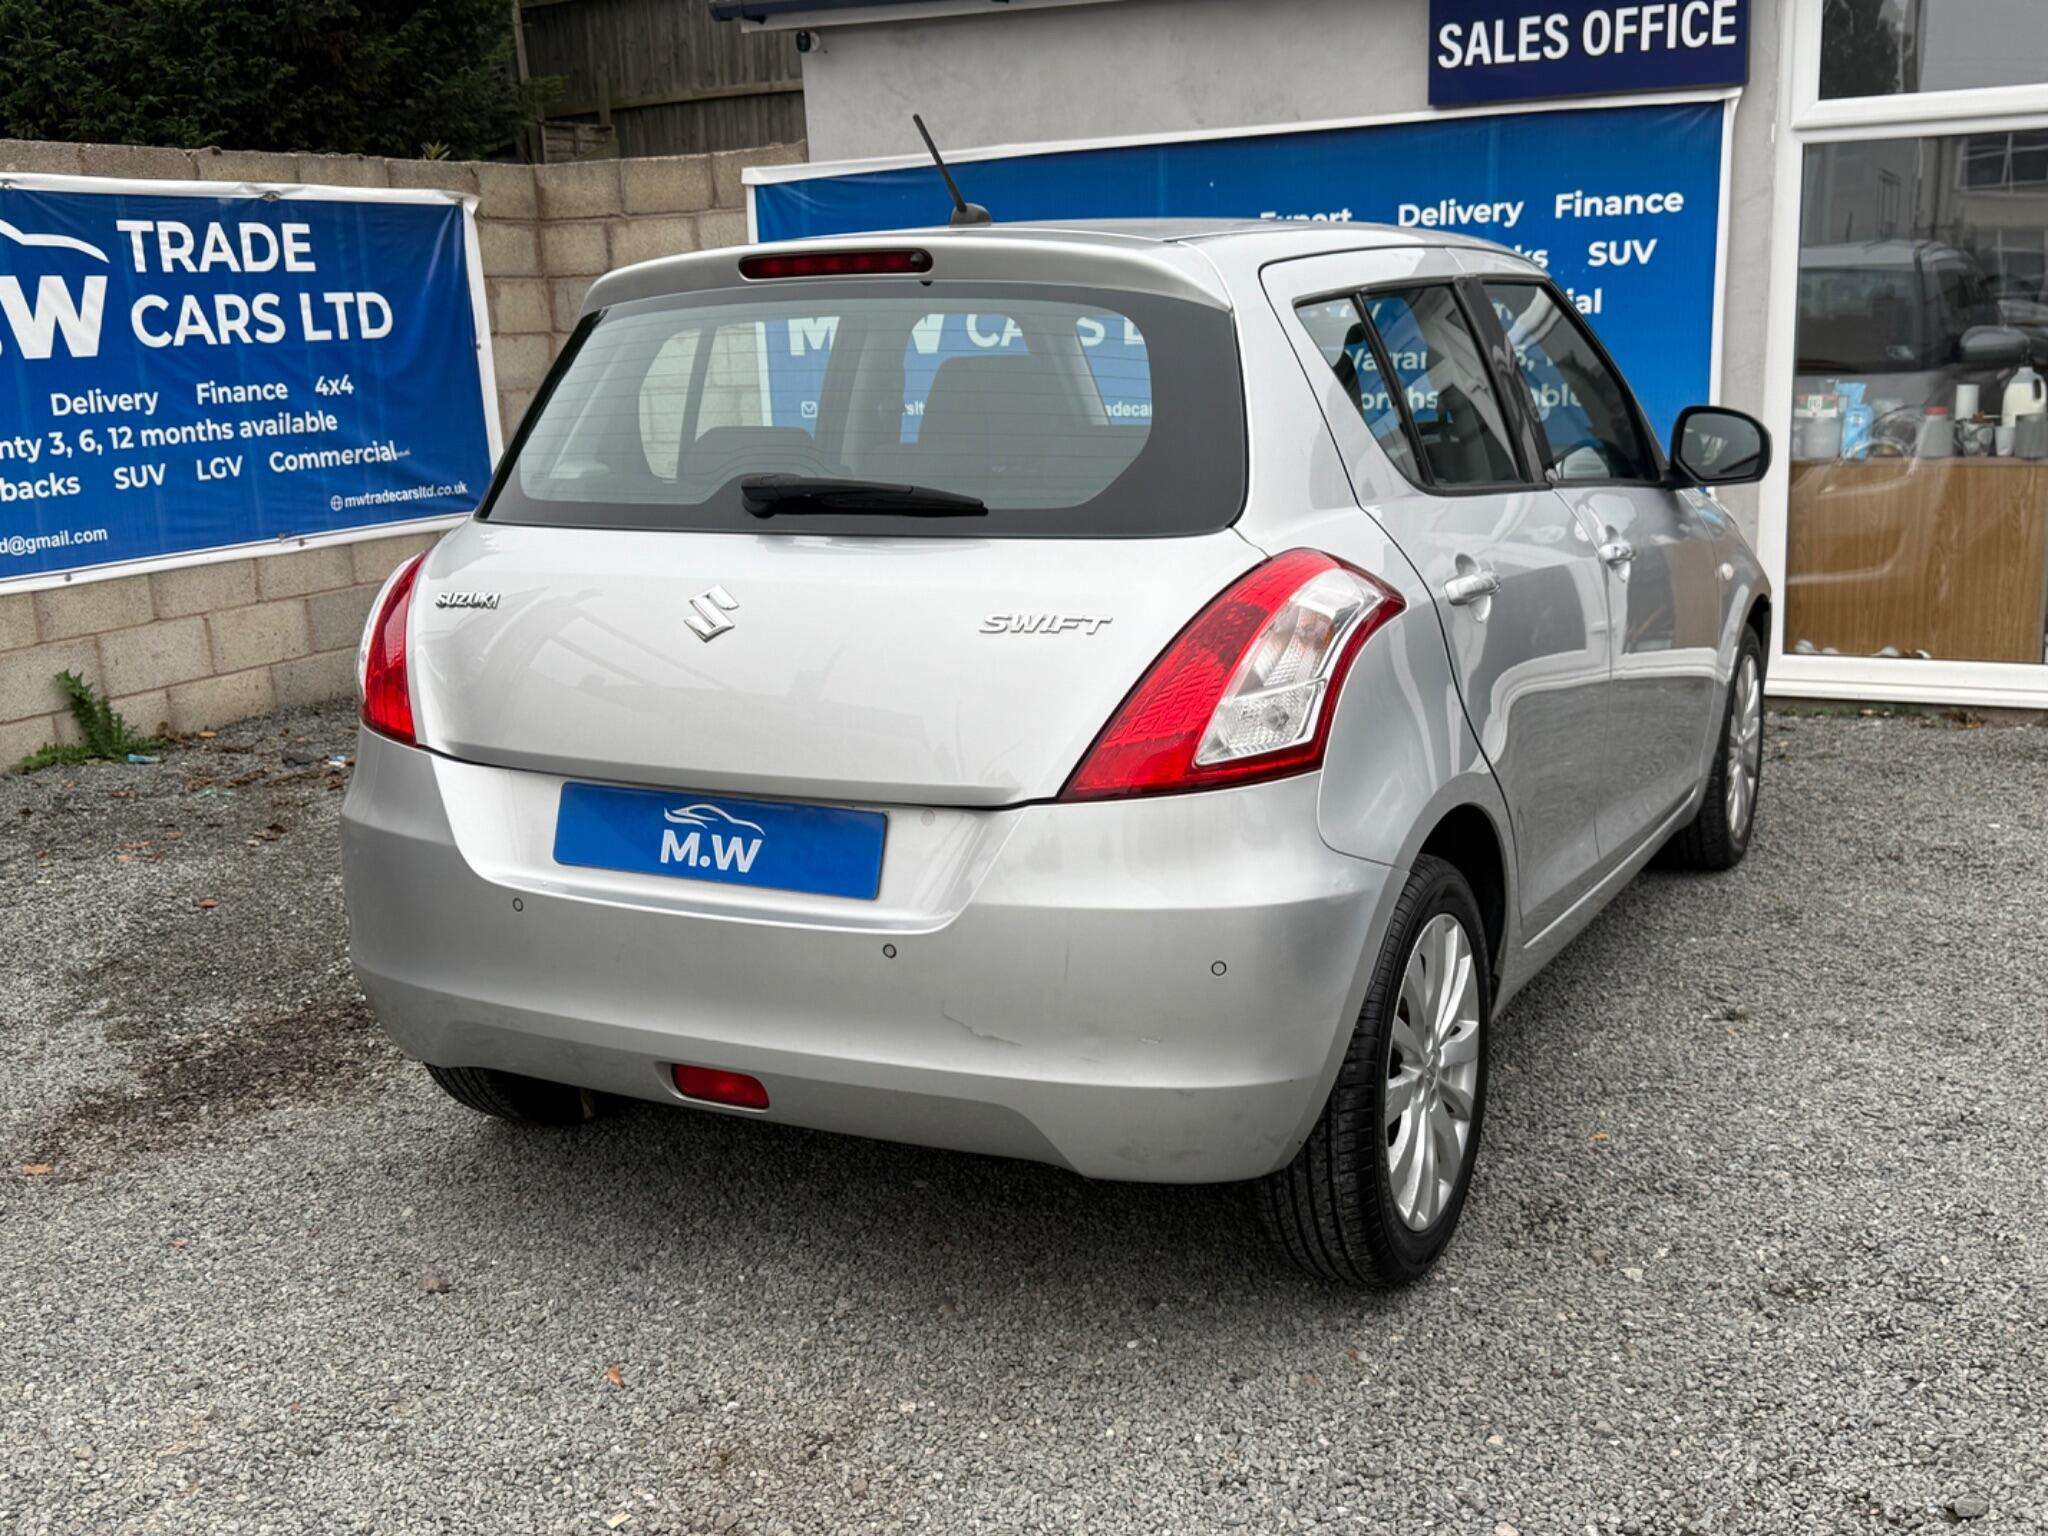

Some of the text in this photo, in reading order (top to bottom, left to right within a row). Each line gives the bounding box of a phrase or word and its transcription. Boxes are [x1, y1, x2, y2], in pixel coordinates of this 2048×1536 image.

[1437, 0, 1738, 69] SALES OFFICE
[1397, 198, 1524, 229] Delivery
[1555, 190, 1684, 219] Finance
[116, 219, 316, 273] TRADE
[1588, 239, 1657, 267] SUV
[131, 291, 393, 348] CARS LTD
[51, 374, 354, 416] Delivery Finance 4x4
[48, 431, 73, 458] 3,
[79, 428, 103, 455] 6,
[107, 426, 134, 450] 12
[141, 418, 234, 447] months
[240, 410, 338, 438] available
[114, 463, 166, 490] SUV
[197, 455, 243, 481] LGV
[269, 440, 398, 473] Commercial
[344, 480, 468, 508] mwtradecarsltd.co.uk
[435, 591, 501, 609] SUZUKI
[979, 613, 1113, 635] SWIFT
[660, 829, 763, 874] M.W
